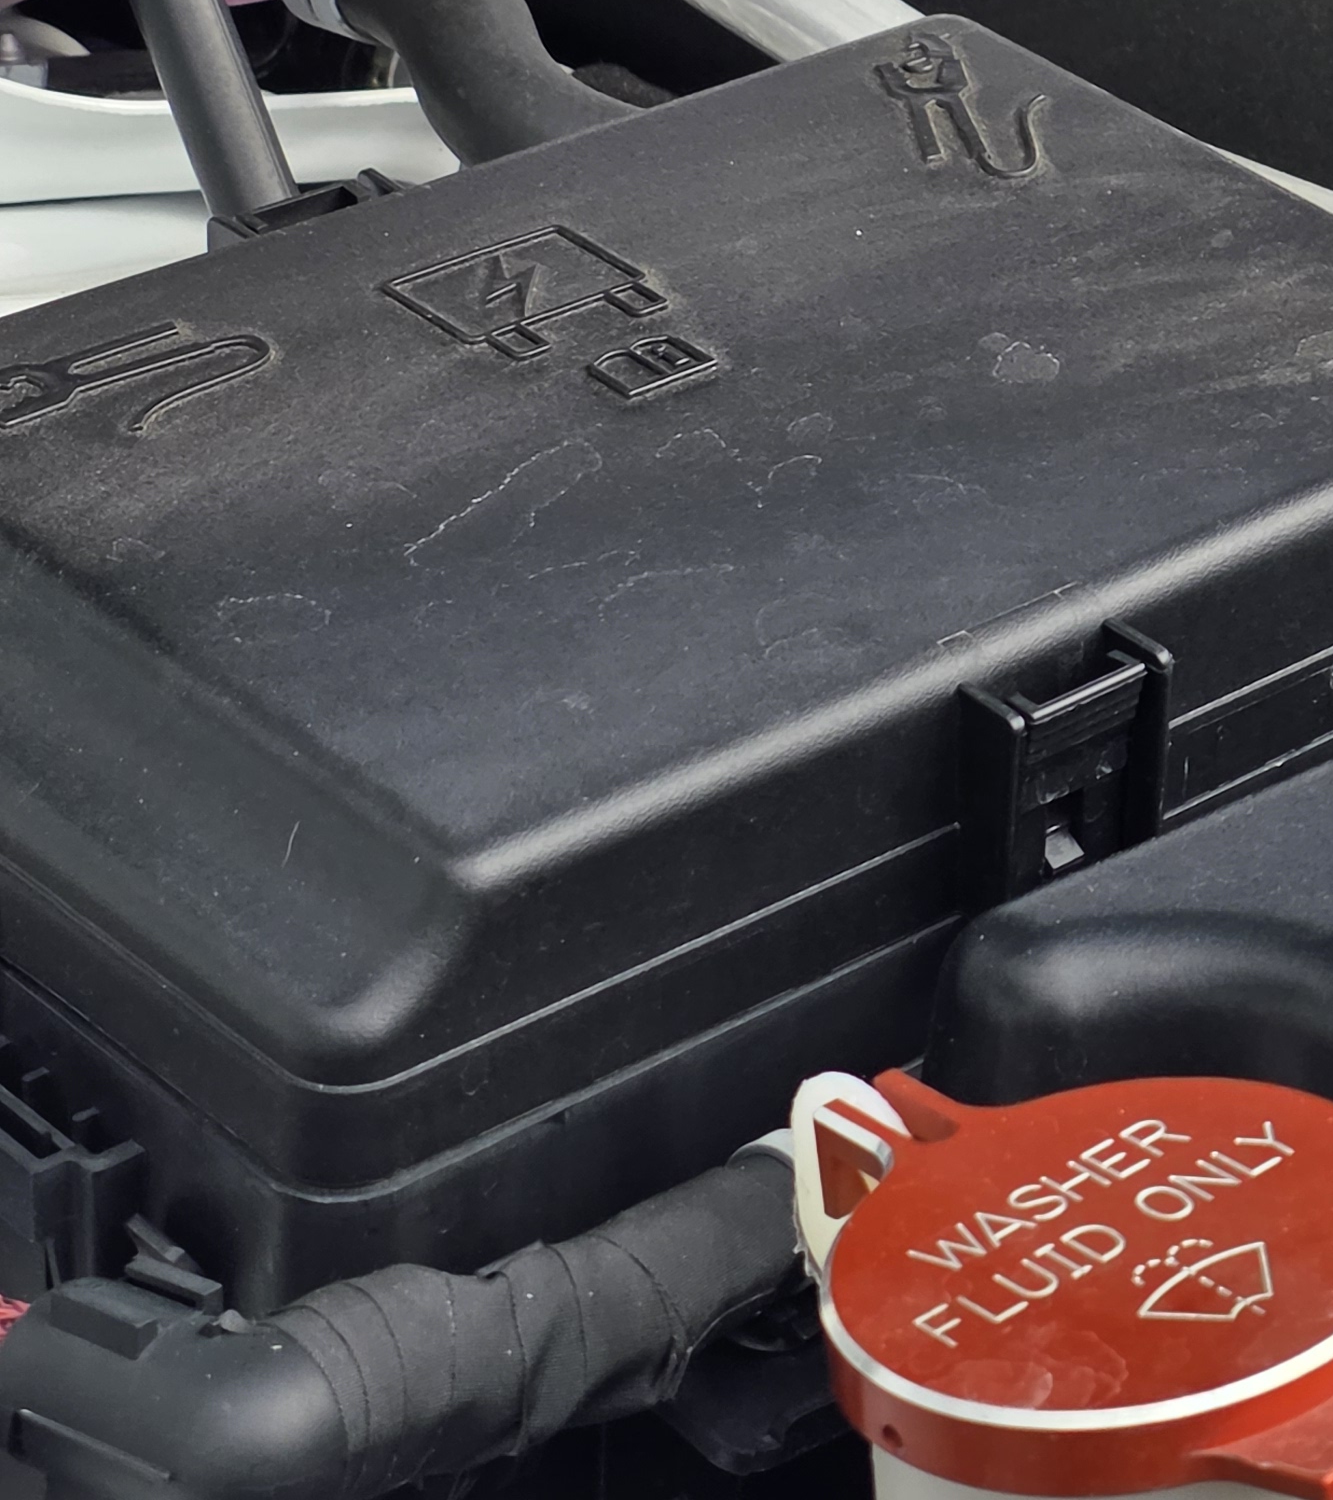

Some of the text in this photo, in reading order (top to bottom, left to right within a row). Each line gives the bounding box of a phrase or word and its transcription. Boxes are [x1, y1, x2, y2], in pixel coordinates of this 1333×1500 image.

[906, 1118, 1192, 1271] WASHER
[912, 1120, 1296, 1349] FLUID ONLY
